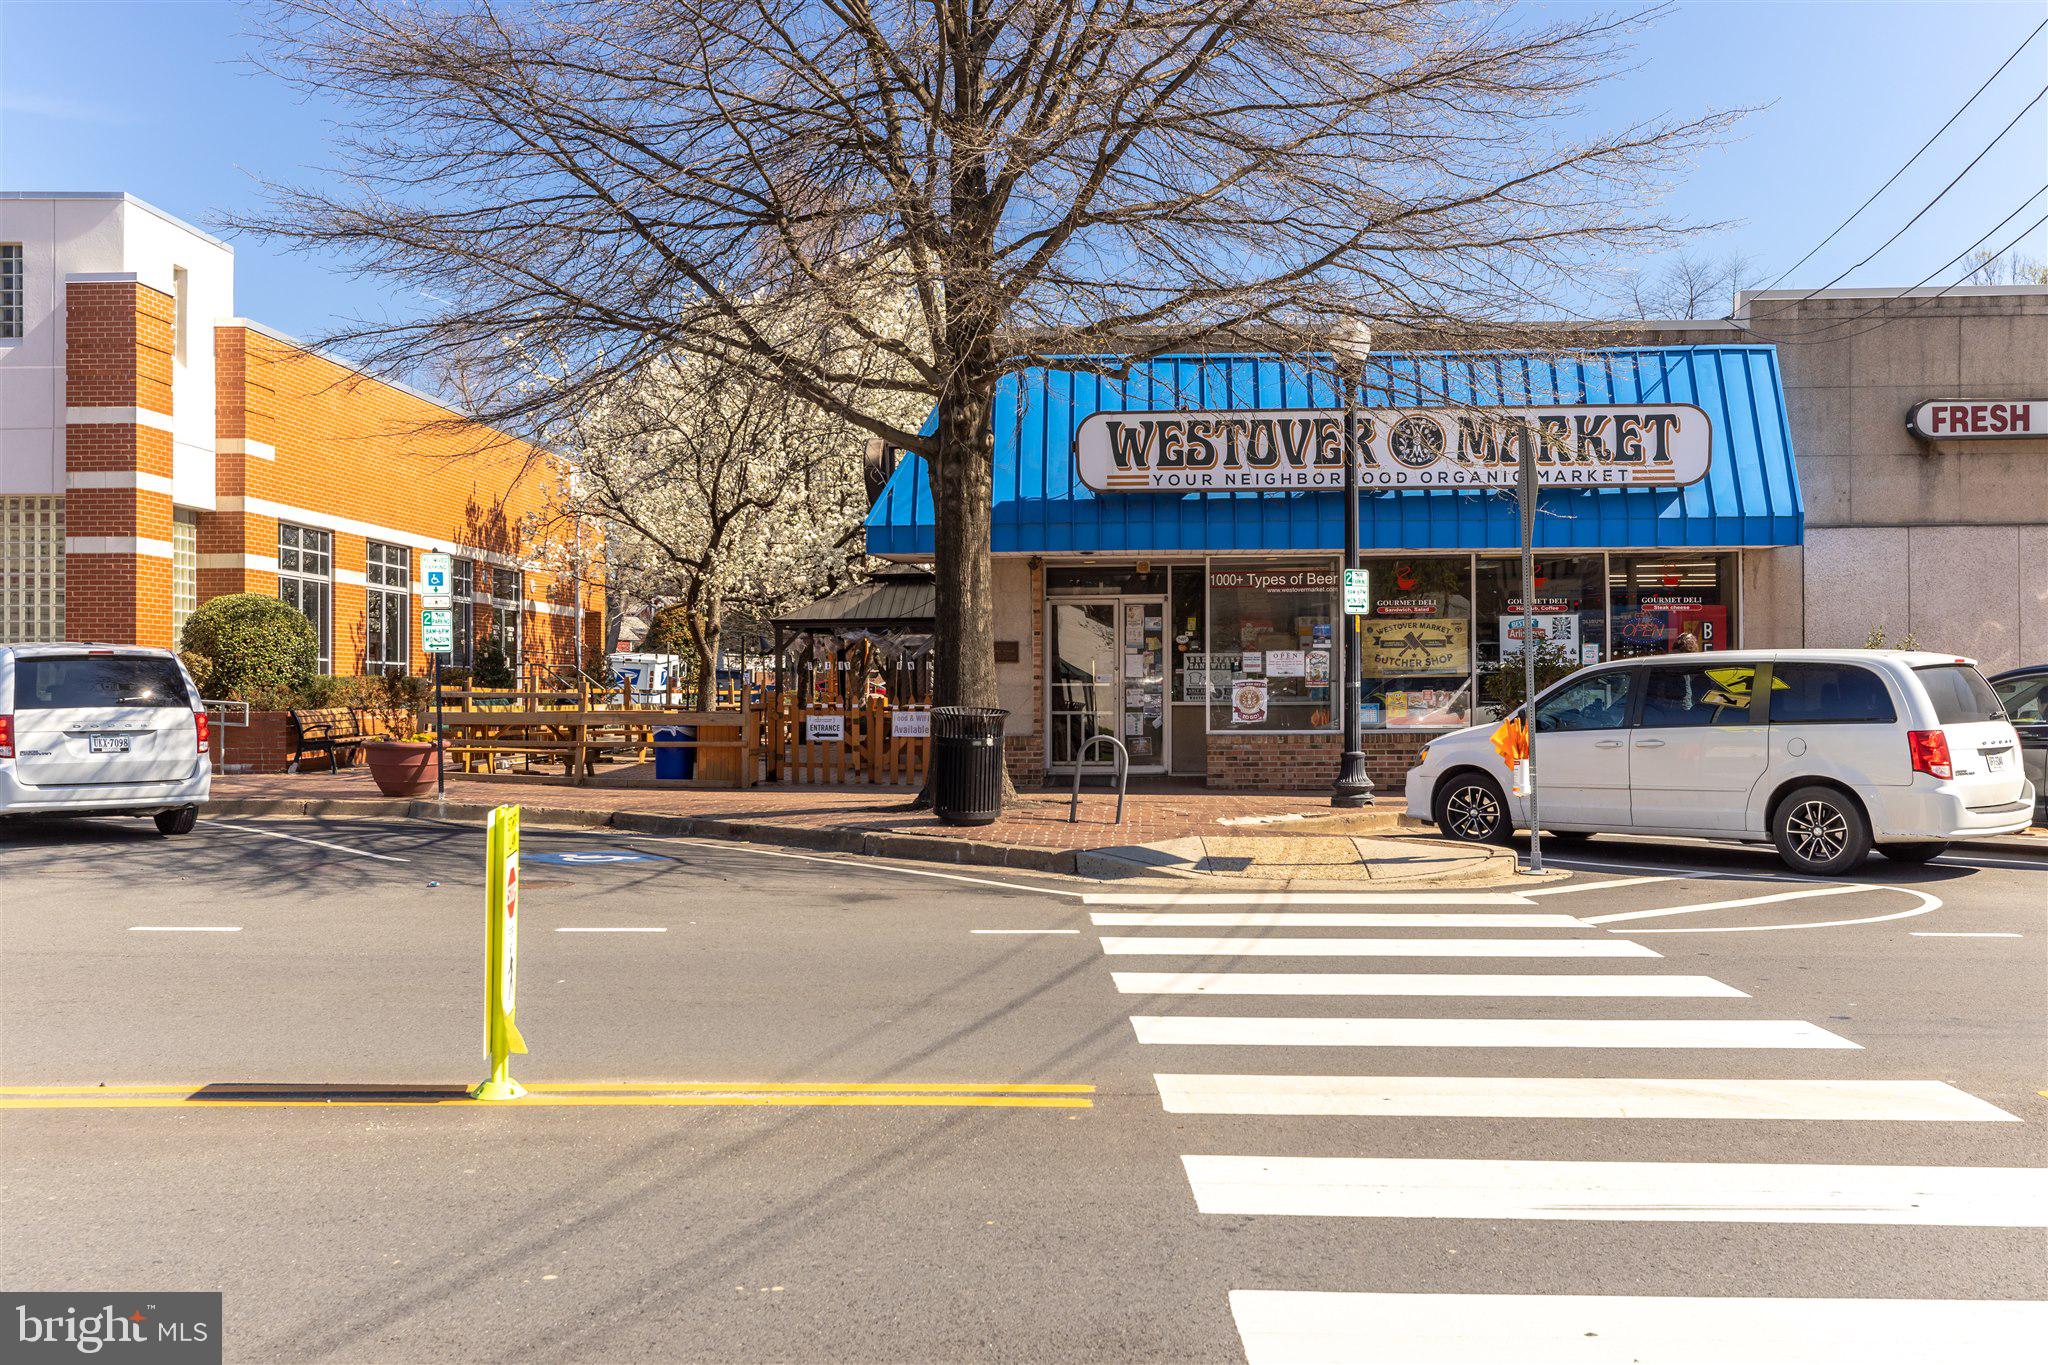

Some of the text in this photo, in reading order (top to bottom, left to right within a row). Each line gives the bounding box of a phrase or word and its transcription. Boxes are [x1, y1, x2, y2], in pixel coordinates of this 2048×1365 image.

[1932, 405, 2029, 433] FRESH
[1106, 414, 1681, 471] WESTOVER MARKET
[1153, 474, 1212, 486] YOUR
[1225, 471, 1407, 486] NEIGHBOROOD
[1538, 469, 1629, 483] MARKET
[1210, 572, 1338, 588] 1000+ Types of Beer
[1345, 570, 1353, 586] 2
[423, 612, 432, 626] 2
[1376, 622, 1451, 635] WESTOVER MARKET
[1622, 623, 1665, 637] OPEN
[1374, 653, 1453, 667] BUTCHER SHOP
[810, 724, 840, 732] ENTRANCE
[894, 725, 929, 734] Available
